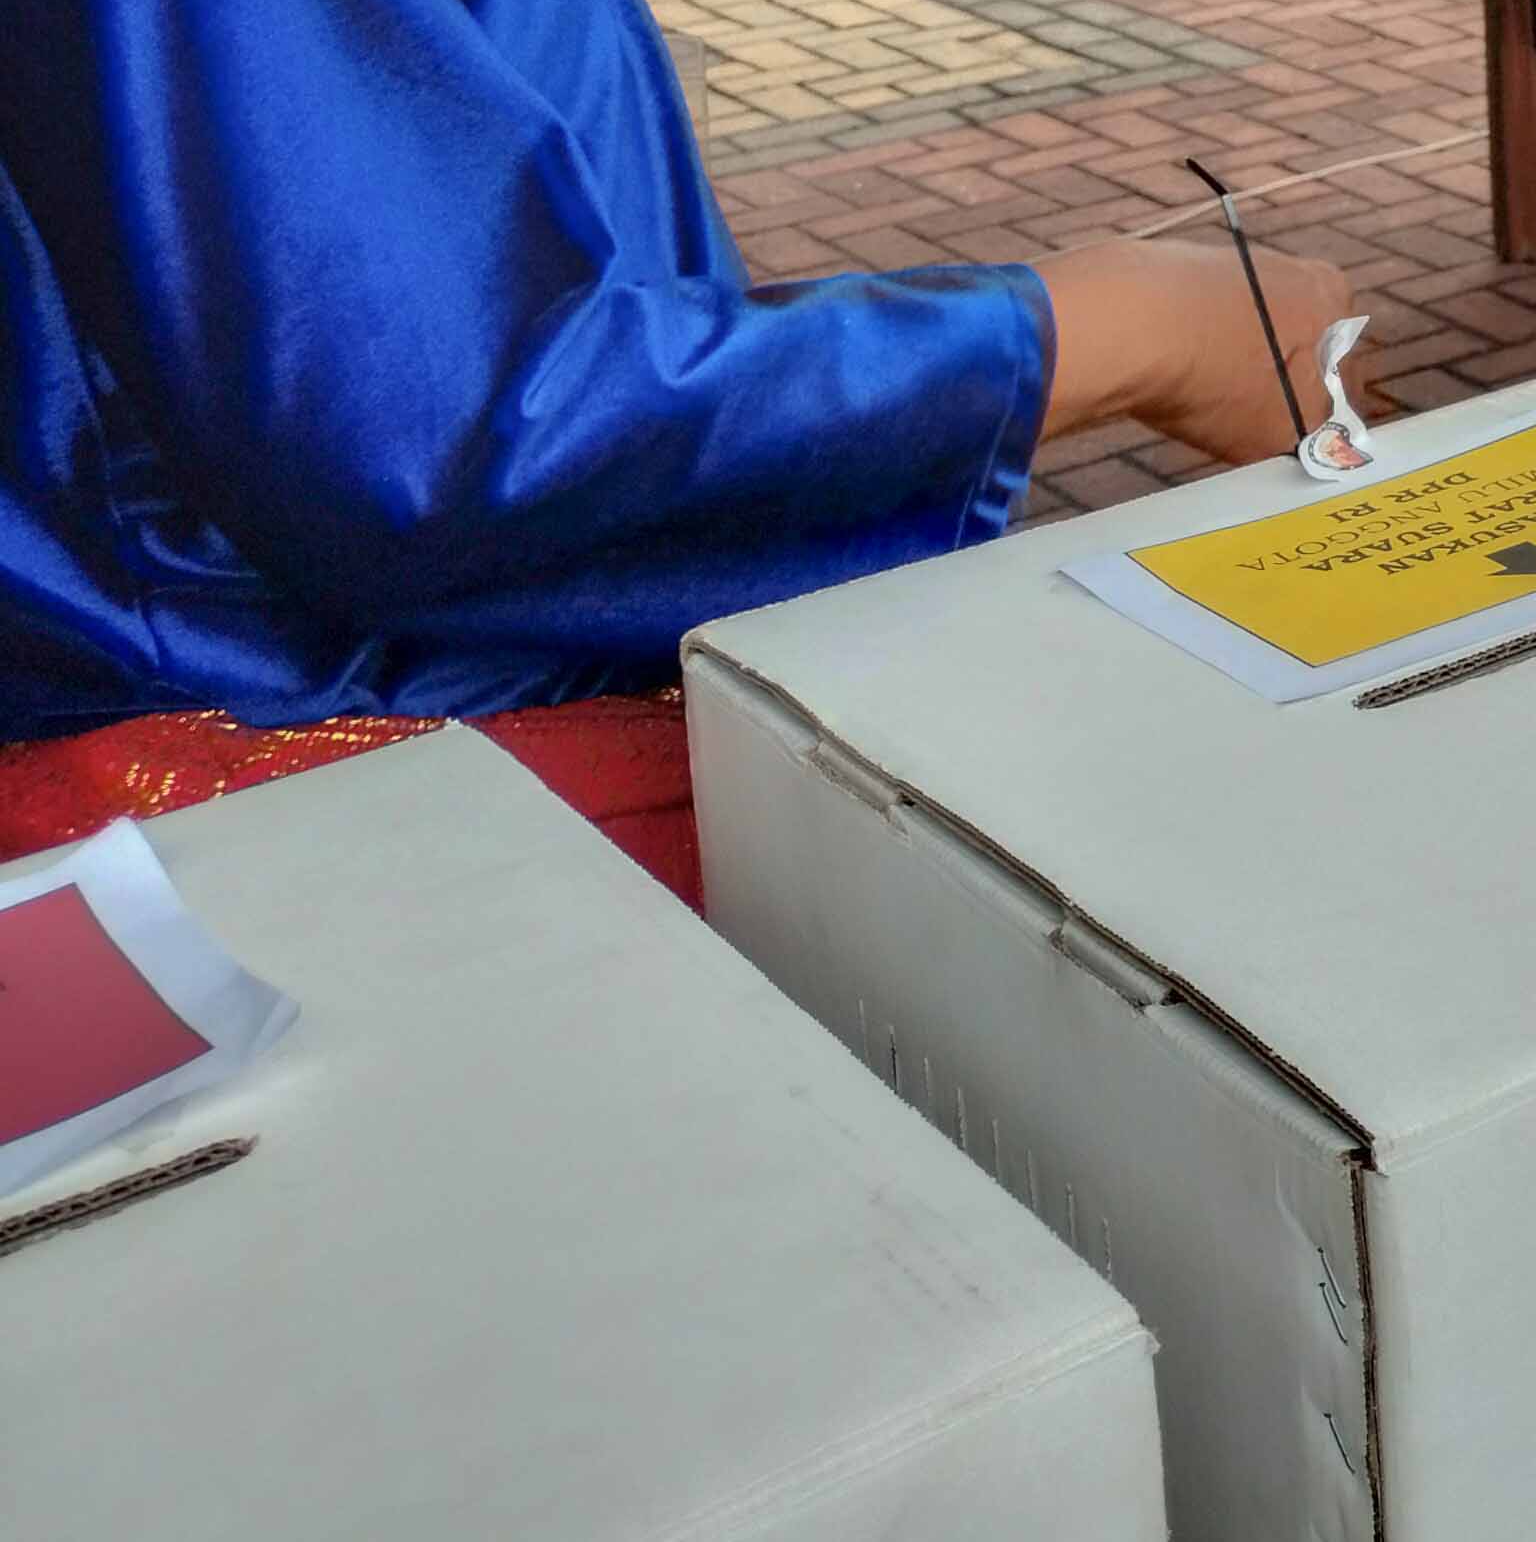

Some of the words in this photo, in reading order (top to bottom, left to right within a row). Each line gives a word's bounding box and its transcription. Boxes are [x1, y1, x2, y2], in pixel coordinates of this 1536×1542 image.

[1383, 471, 1479, 504] DPR
[1324, 501, 1383, 524] RI
[1235, 500, 1442, 571] ANGGOTA
[1300, 520, 1455, 572] SUARA
